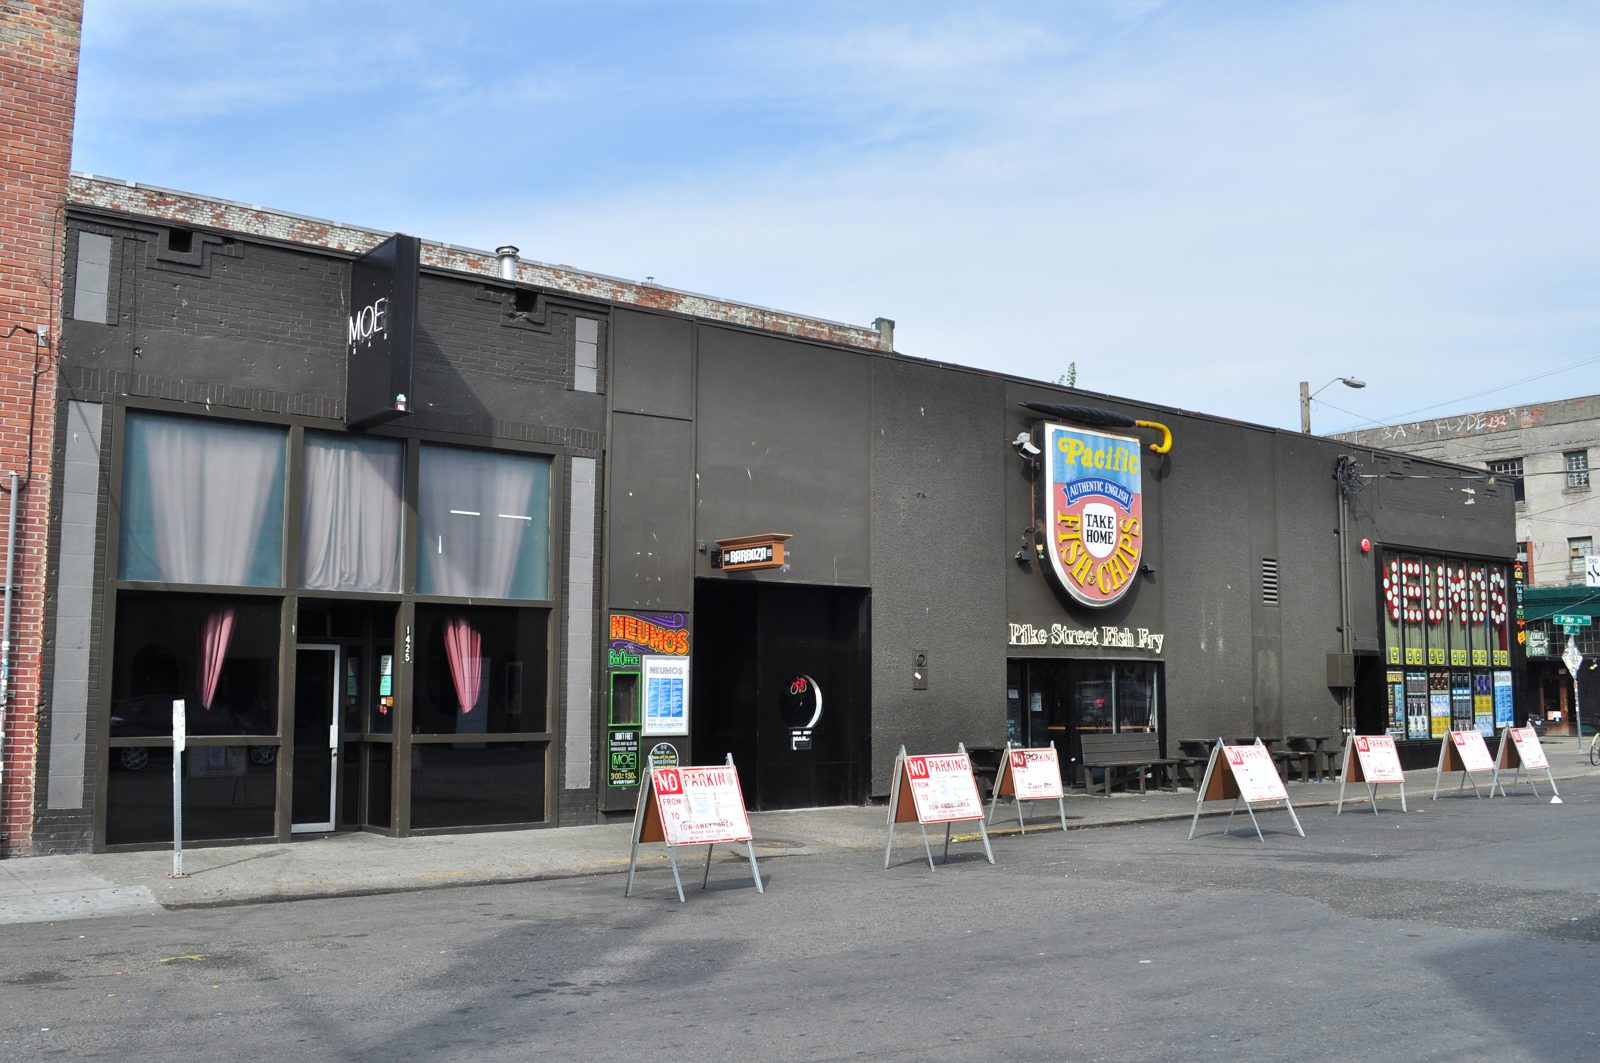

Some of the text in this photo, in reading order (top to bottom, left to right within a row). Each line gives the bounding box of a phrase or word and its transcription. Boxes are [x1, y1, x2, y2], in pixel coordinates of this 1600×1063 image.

[349, 298, 386, 345] MOE
[1058, 437, 1139, 474] Pacific
[1069, 481, 1130, 504] AUTHENTIC ENGLISH
[1085, 513, 1114, 530] TAKE
[1086, 530, 1114, 545] HOME
[730, 547, 767, 564] BARBOZA
[1057, 510, 1095, 587] FISH
[1097, 517, 1141, 595] CHIPS
[1383, 559, 1507, 625] NEUMOS
[1560, 615, 1575, 624] Pike
[610, 615, 690, 656] NEUMOS
[1009, 623, 1165, 654] Pike Street Fish Fry
[649, 666, 684, 675] NEUMOS
[1357, 738, 1393, 749] NO PARKING
[613, 754, 635, 765] MOE
[910, 758, 968, 776] NO PARKING
[1012, 753, 1024, 765] NO
[658, 771, 734, 792] NO PARKING
[662, 798, 682, 806] FROM
[671, 812, 680, 820] TO
[680, 823, 712, 831] TOW-AWAY
